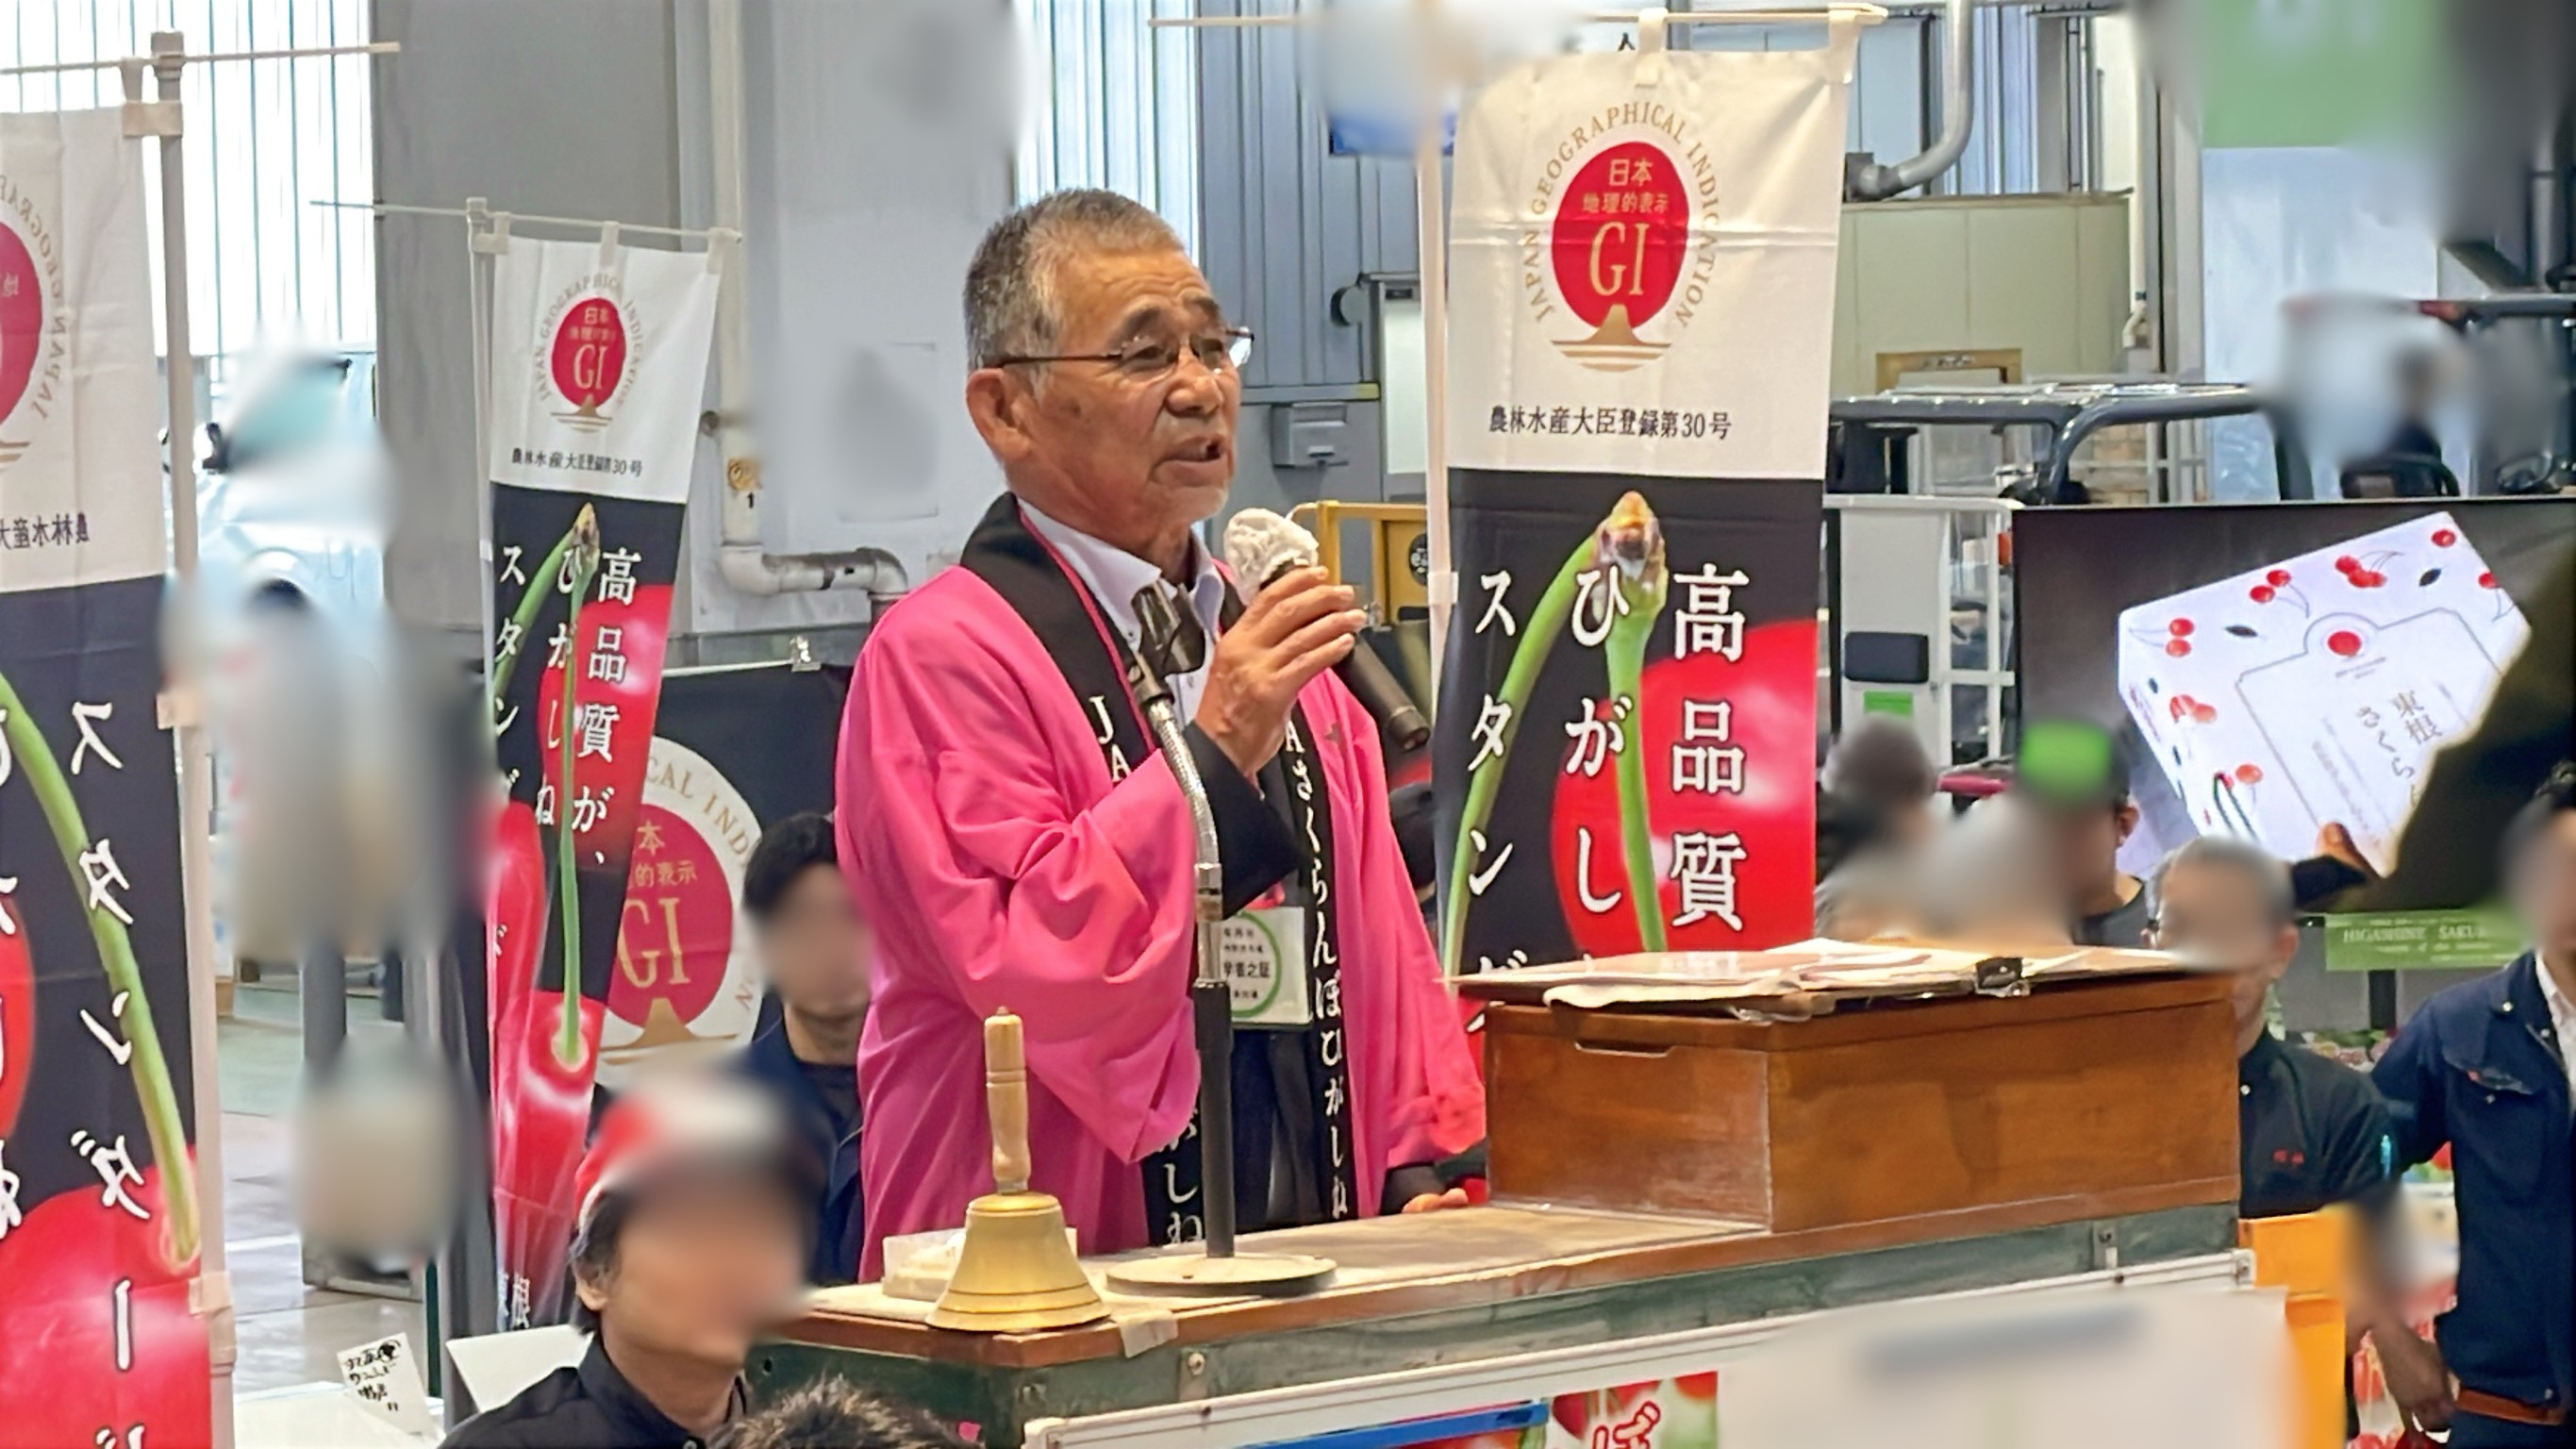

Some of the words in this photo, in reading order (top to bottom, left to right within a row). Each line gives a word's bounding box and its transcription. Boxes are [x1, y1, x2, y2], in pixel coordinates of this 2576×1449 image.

[1530, 100, 1687, 216] GEOGRAPHICAL
[1608, 157, 1654, 188] 日本
[1582, 192, 1670, 214] 地理的表示
[1523, 228, 1556, 324] JAPAN
[1589, 220, 1650, 297] GI
[573, 342, 609, 390] GI
[1489, 405, 1733, 441] 農林水産大臣登録第30号
[1089, 694, 1133, 783] JA
[1564, 564, 1633, 972] ひがし
[1670, 562, 1751, 932] 高品質
[629, 859, 698, 890] 的表示
[617, 897, 691, 989] GI
